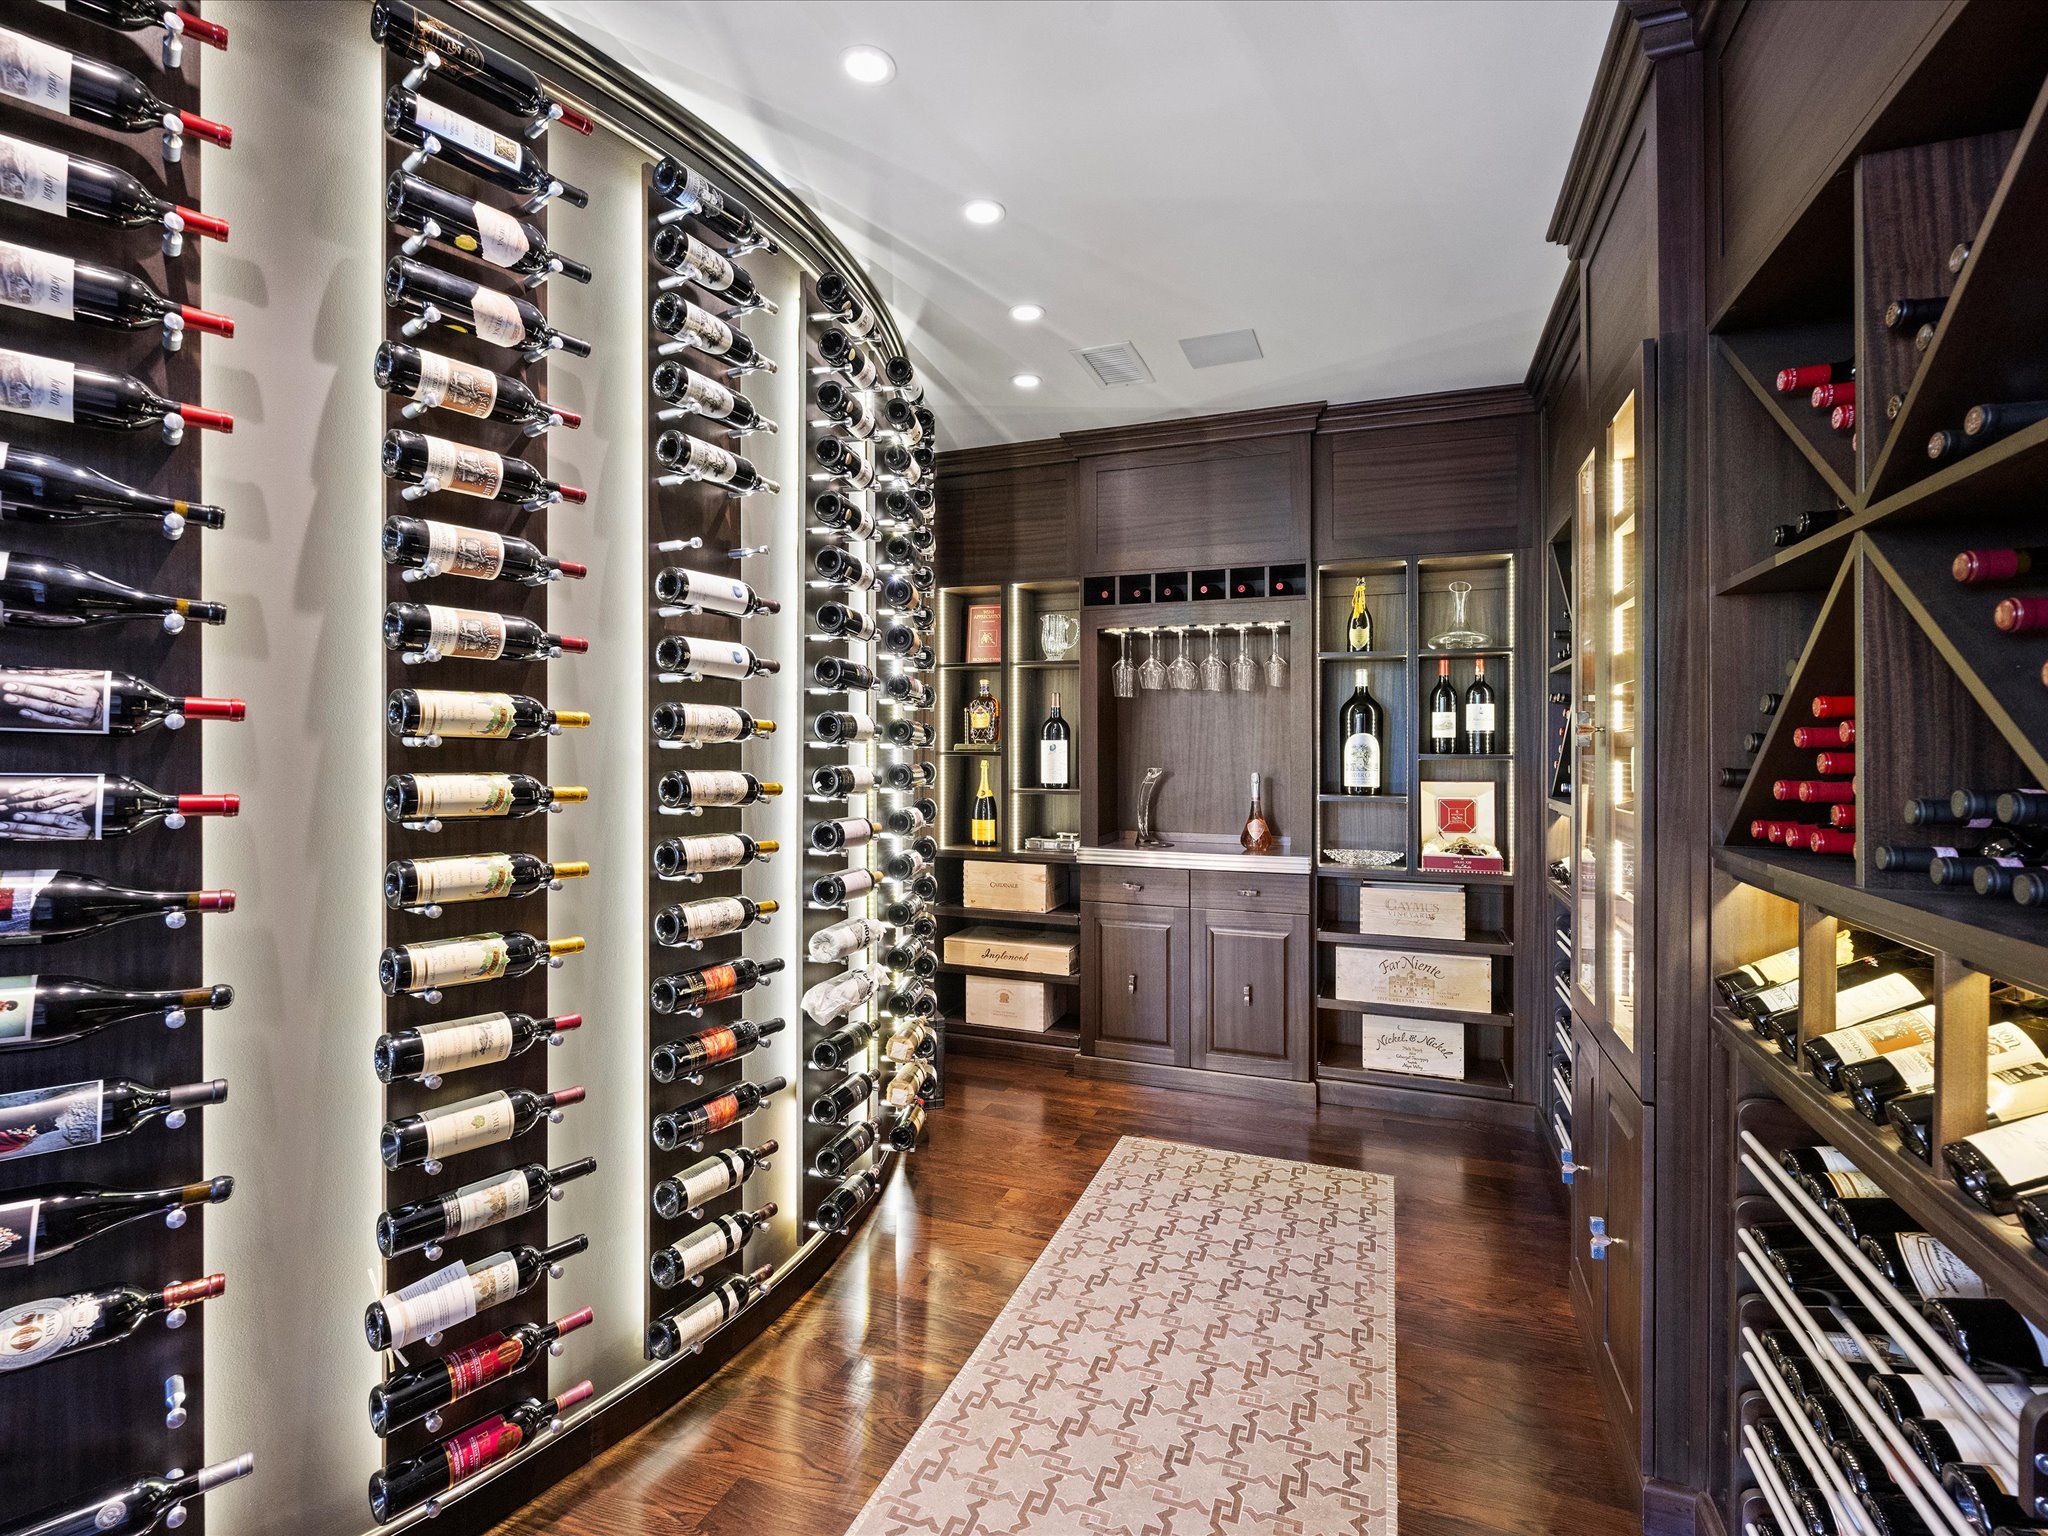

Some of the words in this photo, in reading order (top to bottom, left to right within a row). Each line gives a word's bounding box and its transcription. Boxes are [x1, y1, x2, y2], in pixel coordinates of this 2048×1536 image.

[989, 881, 1019, 889] CARDINALE
[1385, 897, 1440, 913] CAYMUS
[981, 948, 1030, 963] Inglenook
[1379, 959, 1401, 975] Far
[1400, 955, 1445, 980] Niente
[1376, 1032, 1408, 1051] Nickel
[1417, 1035, 1453, 1059] Nickel
[46, 1312, 57, 1337] MASI
